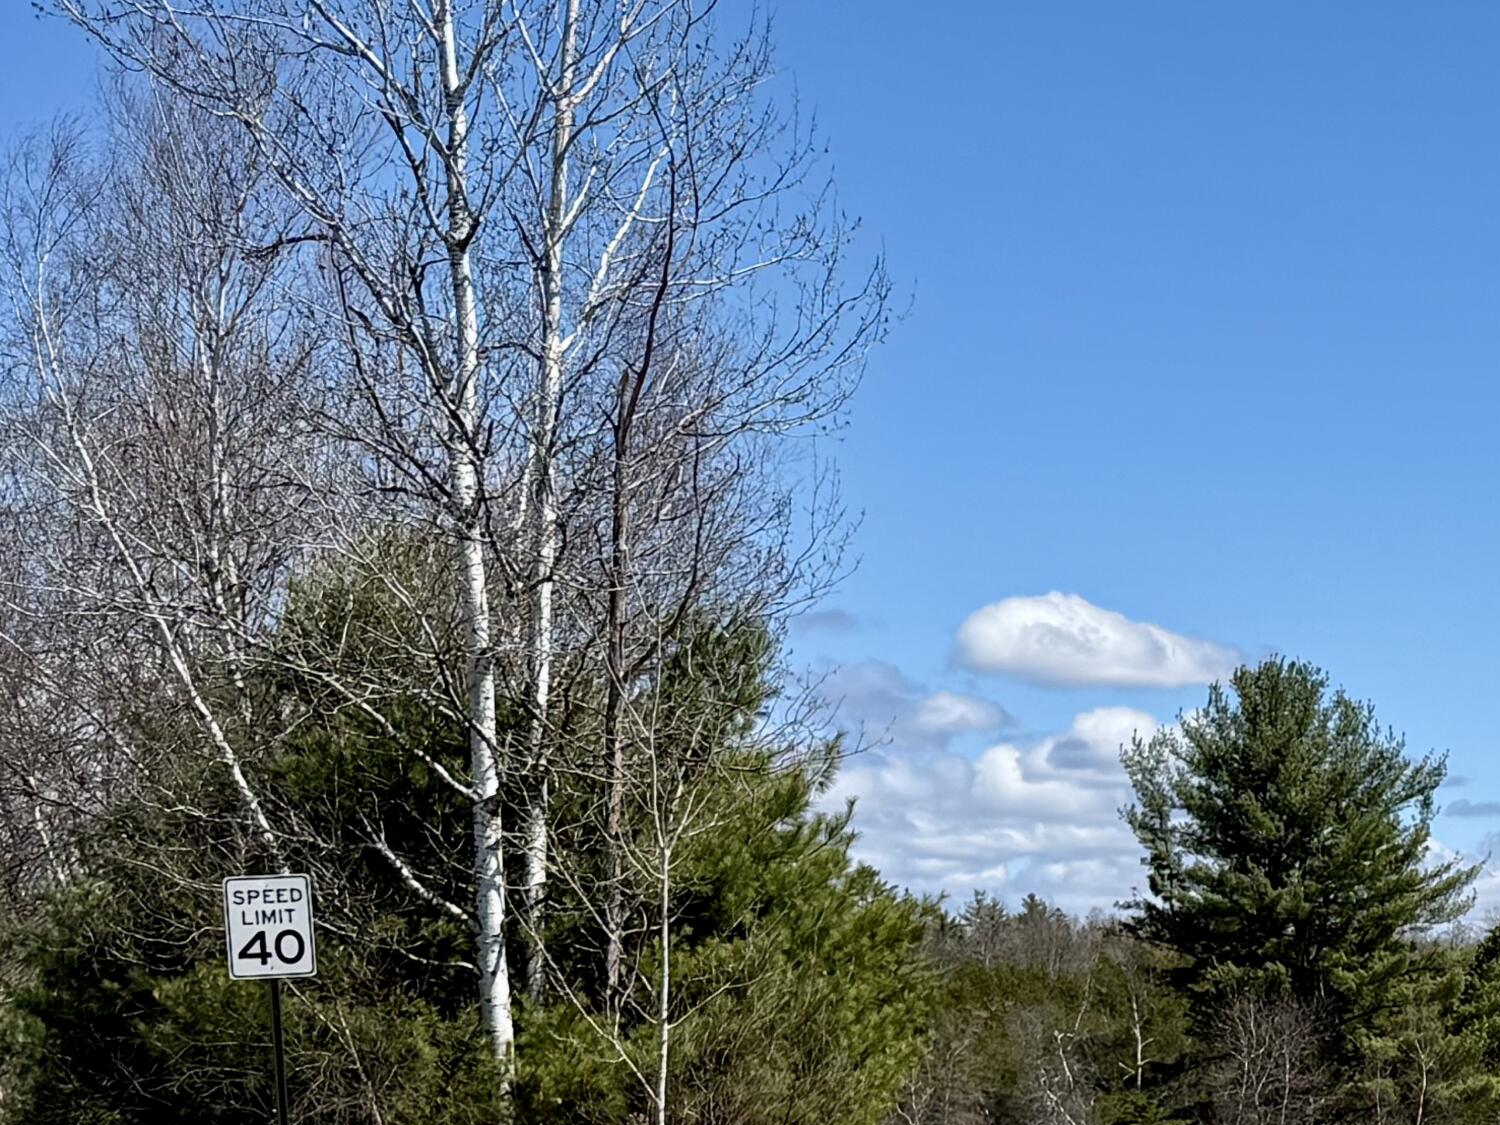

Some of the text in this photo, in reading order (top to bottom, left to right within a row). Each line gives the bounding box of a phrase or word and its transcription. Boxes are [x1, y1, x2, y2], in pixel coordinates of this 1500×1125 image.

[233, 888, 303, 905] SPEED
[242, 908, 296, 925] LIMIT
[238, 929, 305, 965] 40
